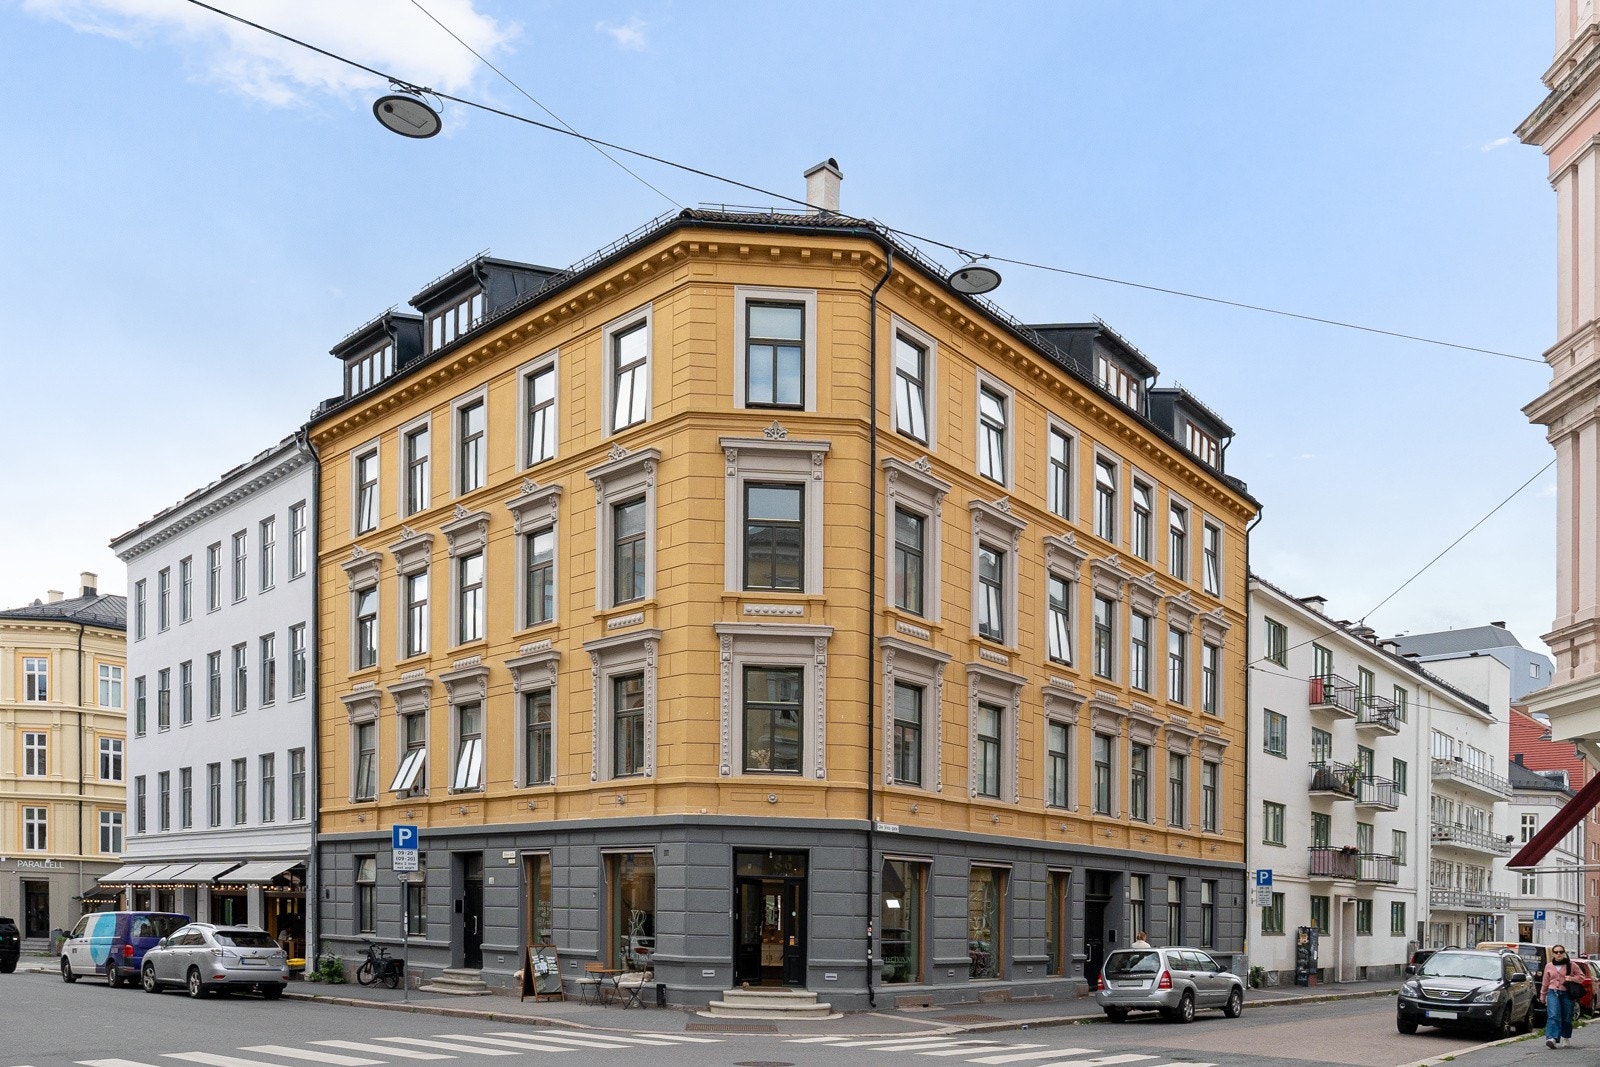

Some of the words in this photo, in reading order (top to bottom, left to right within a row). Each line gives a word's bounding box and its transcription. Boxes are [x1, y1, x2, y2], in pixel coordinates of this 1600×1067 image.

[398, 828, 412, 846] P
[17, 860, 64, 869] PARALLELL
[1260, 871, 1269, 884] P
[1537, 911, 1543, 919] P
